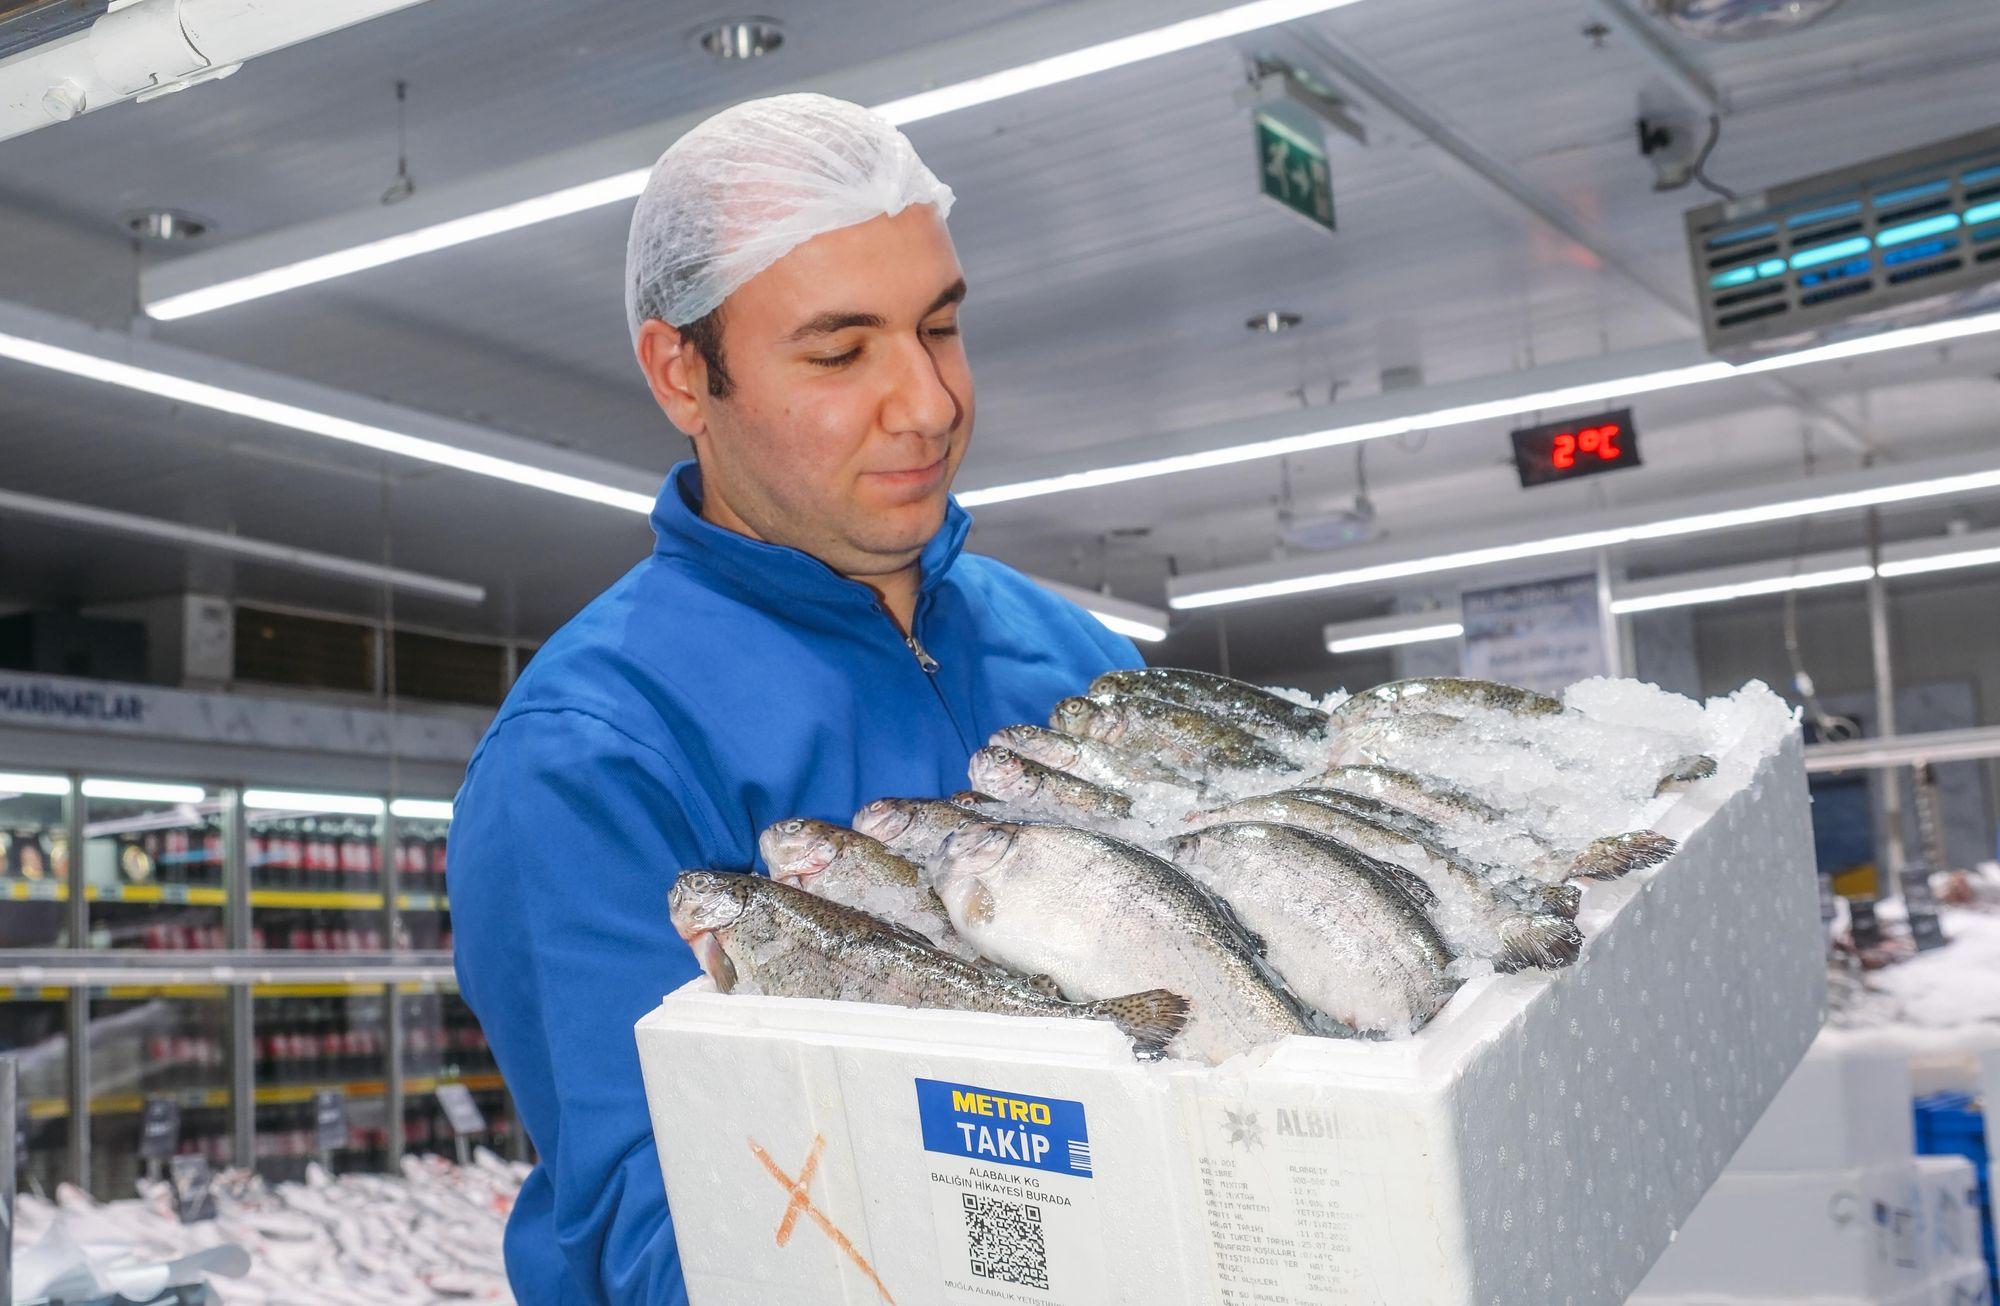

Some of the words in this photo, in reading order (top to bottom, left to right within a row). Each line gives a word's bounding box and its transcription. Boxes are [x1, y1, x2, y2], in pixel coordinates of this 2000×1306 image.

[952, 1090, 1051, 1125] METRO
[956, 1122, 1051, 1163] TAKİP
[931, 1171, 972, 1188] BALIĞIN
[1026, 1190, 1072, 1207] BURADA
[969, 1167, 1022, 1184] ALABALIK
[1024, 1177, 1040, 1188] KG
[975, 1287, 1014, 1301] ALABALIK
